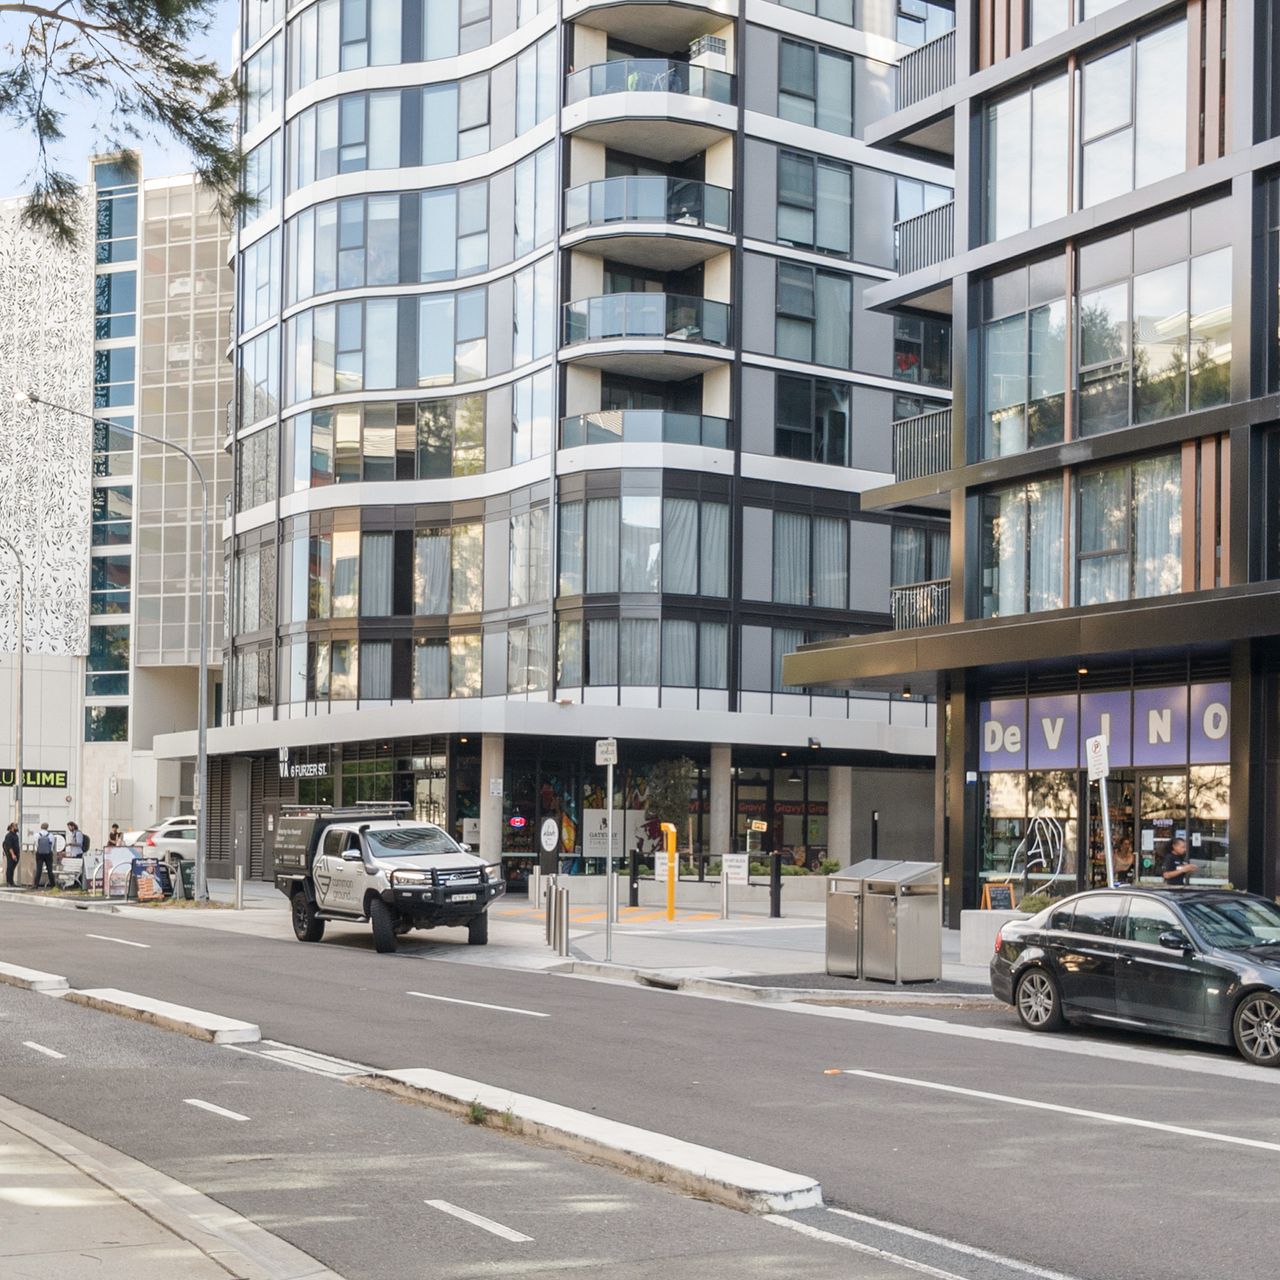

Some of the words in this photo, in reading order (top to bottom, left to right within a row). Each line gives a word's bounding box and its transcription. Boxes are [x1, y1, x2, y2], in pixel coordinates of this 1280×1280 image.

[290, 765, 295, 778] 6
[295, 763, 318, 777] FURZER
[332, 879, 353, 888] common
[333, 890, 351, 901] ground
